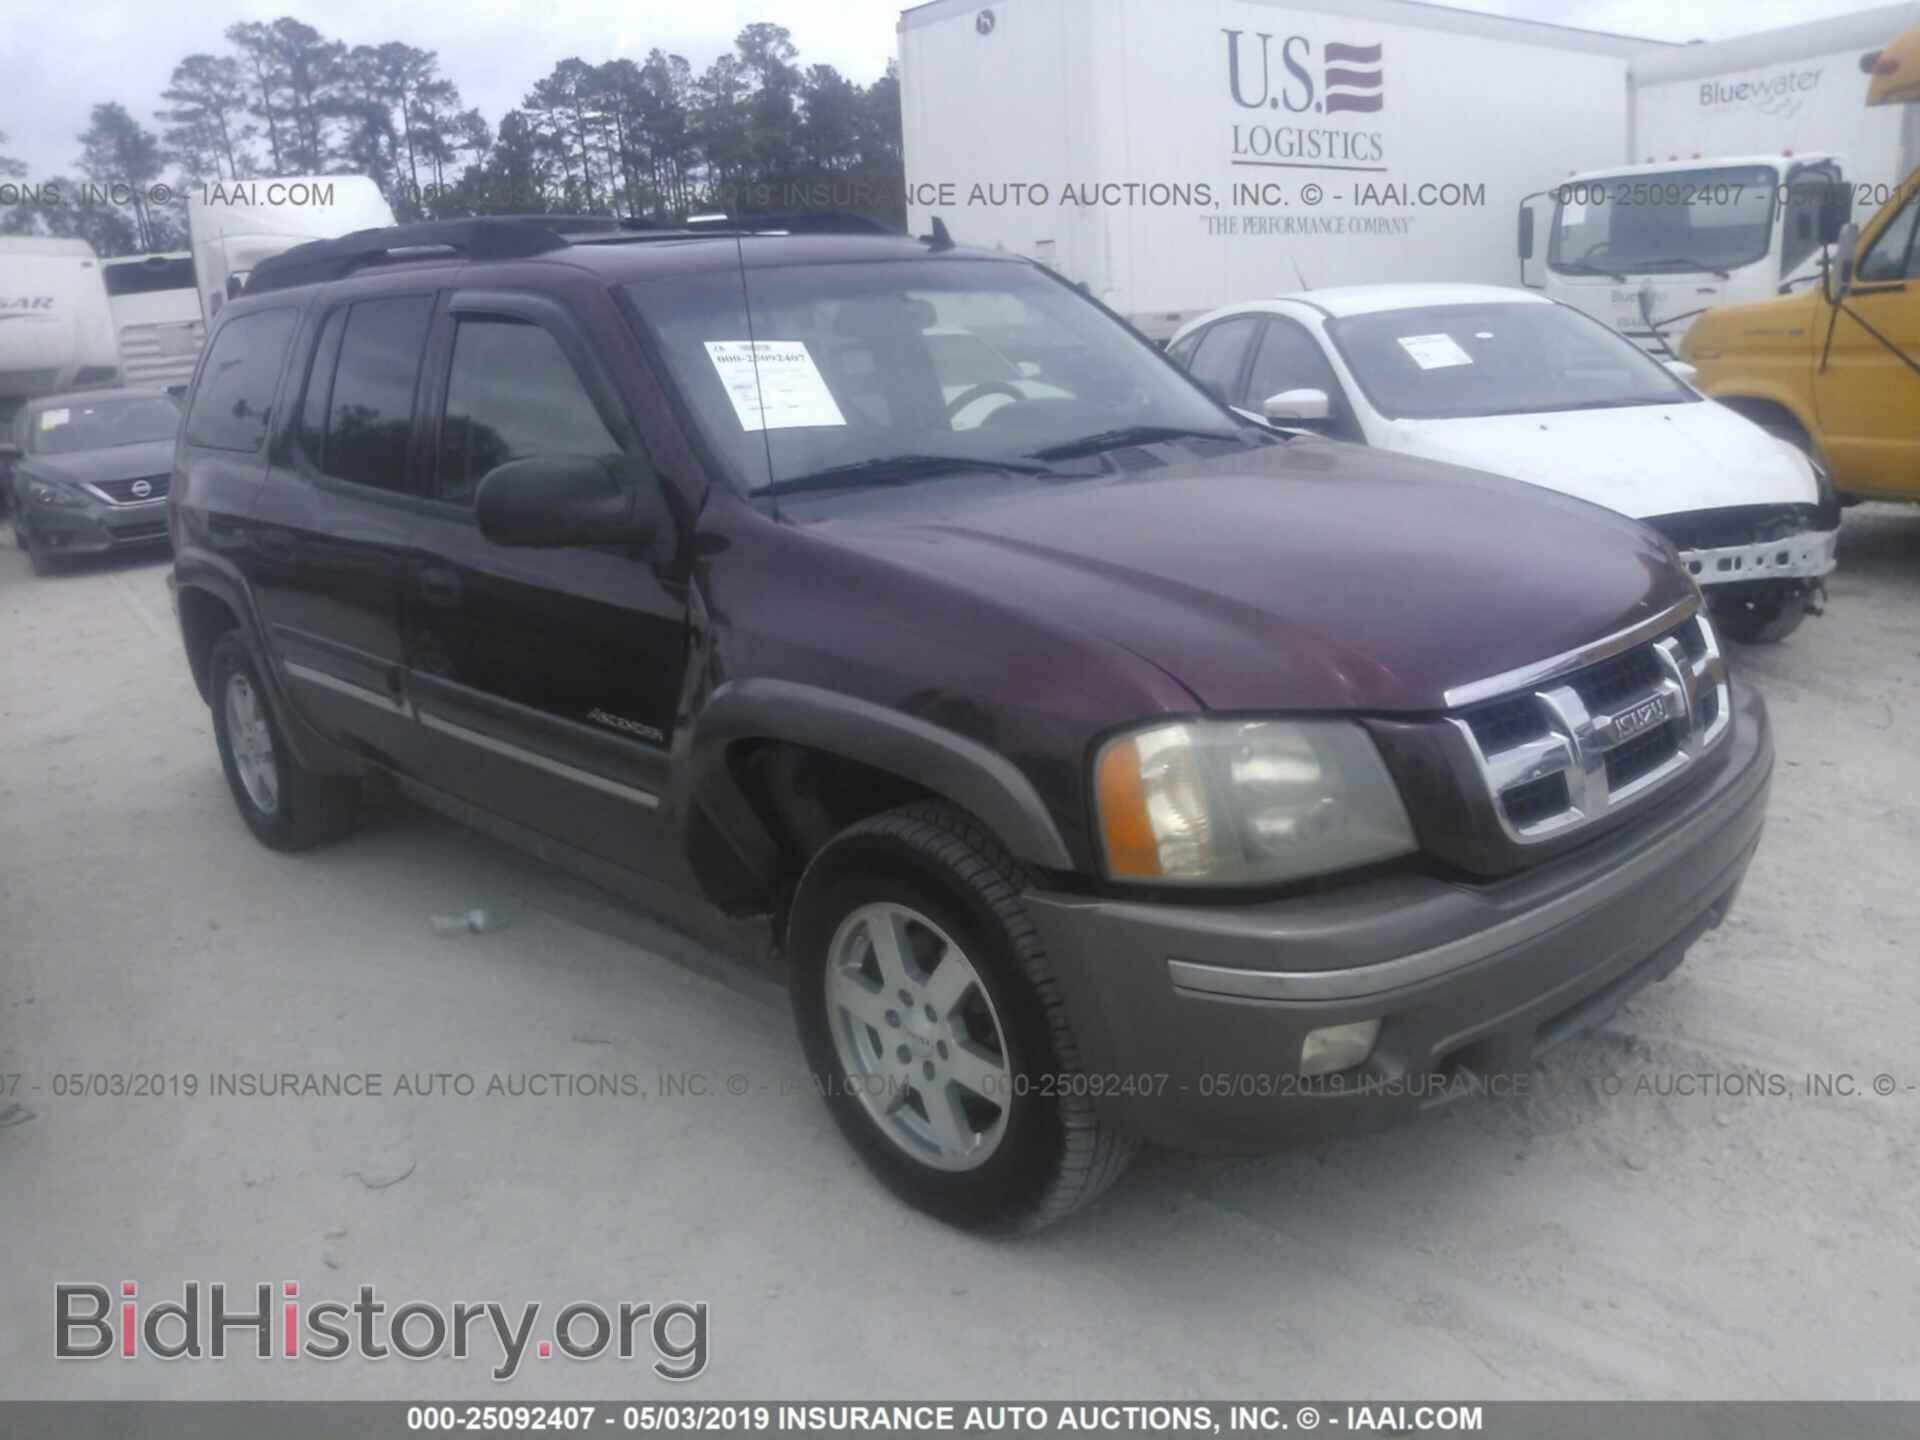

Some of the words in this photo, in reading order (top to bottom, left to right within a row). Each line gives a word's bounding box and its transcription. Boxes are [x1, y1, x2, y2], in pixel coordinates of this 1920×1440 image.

[1220, 29, 1323, 113] U.S.
[1700, 69, 1823, 106] Bluewater
[1231, 124, 1384, 162] LOGISTICS
[1242, 215, 1344, 236] PERFORMANCE
[1615, 698, 1665, 738] ISUZU
